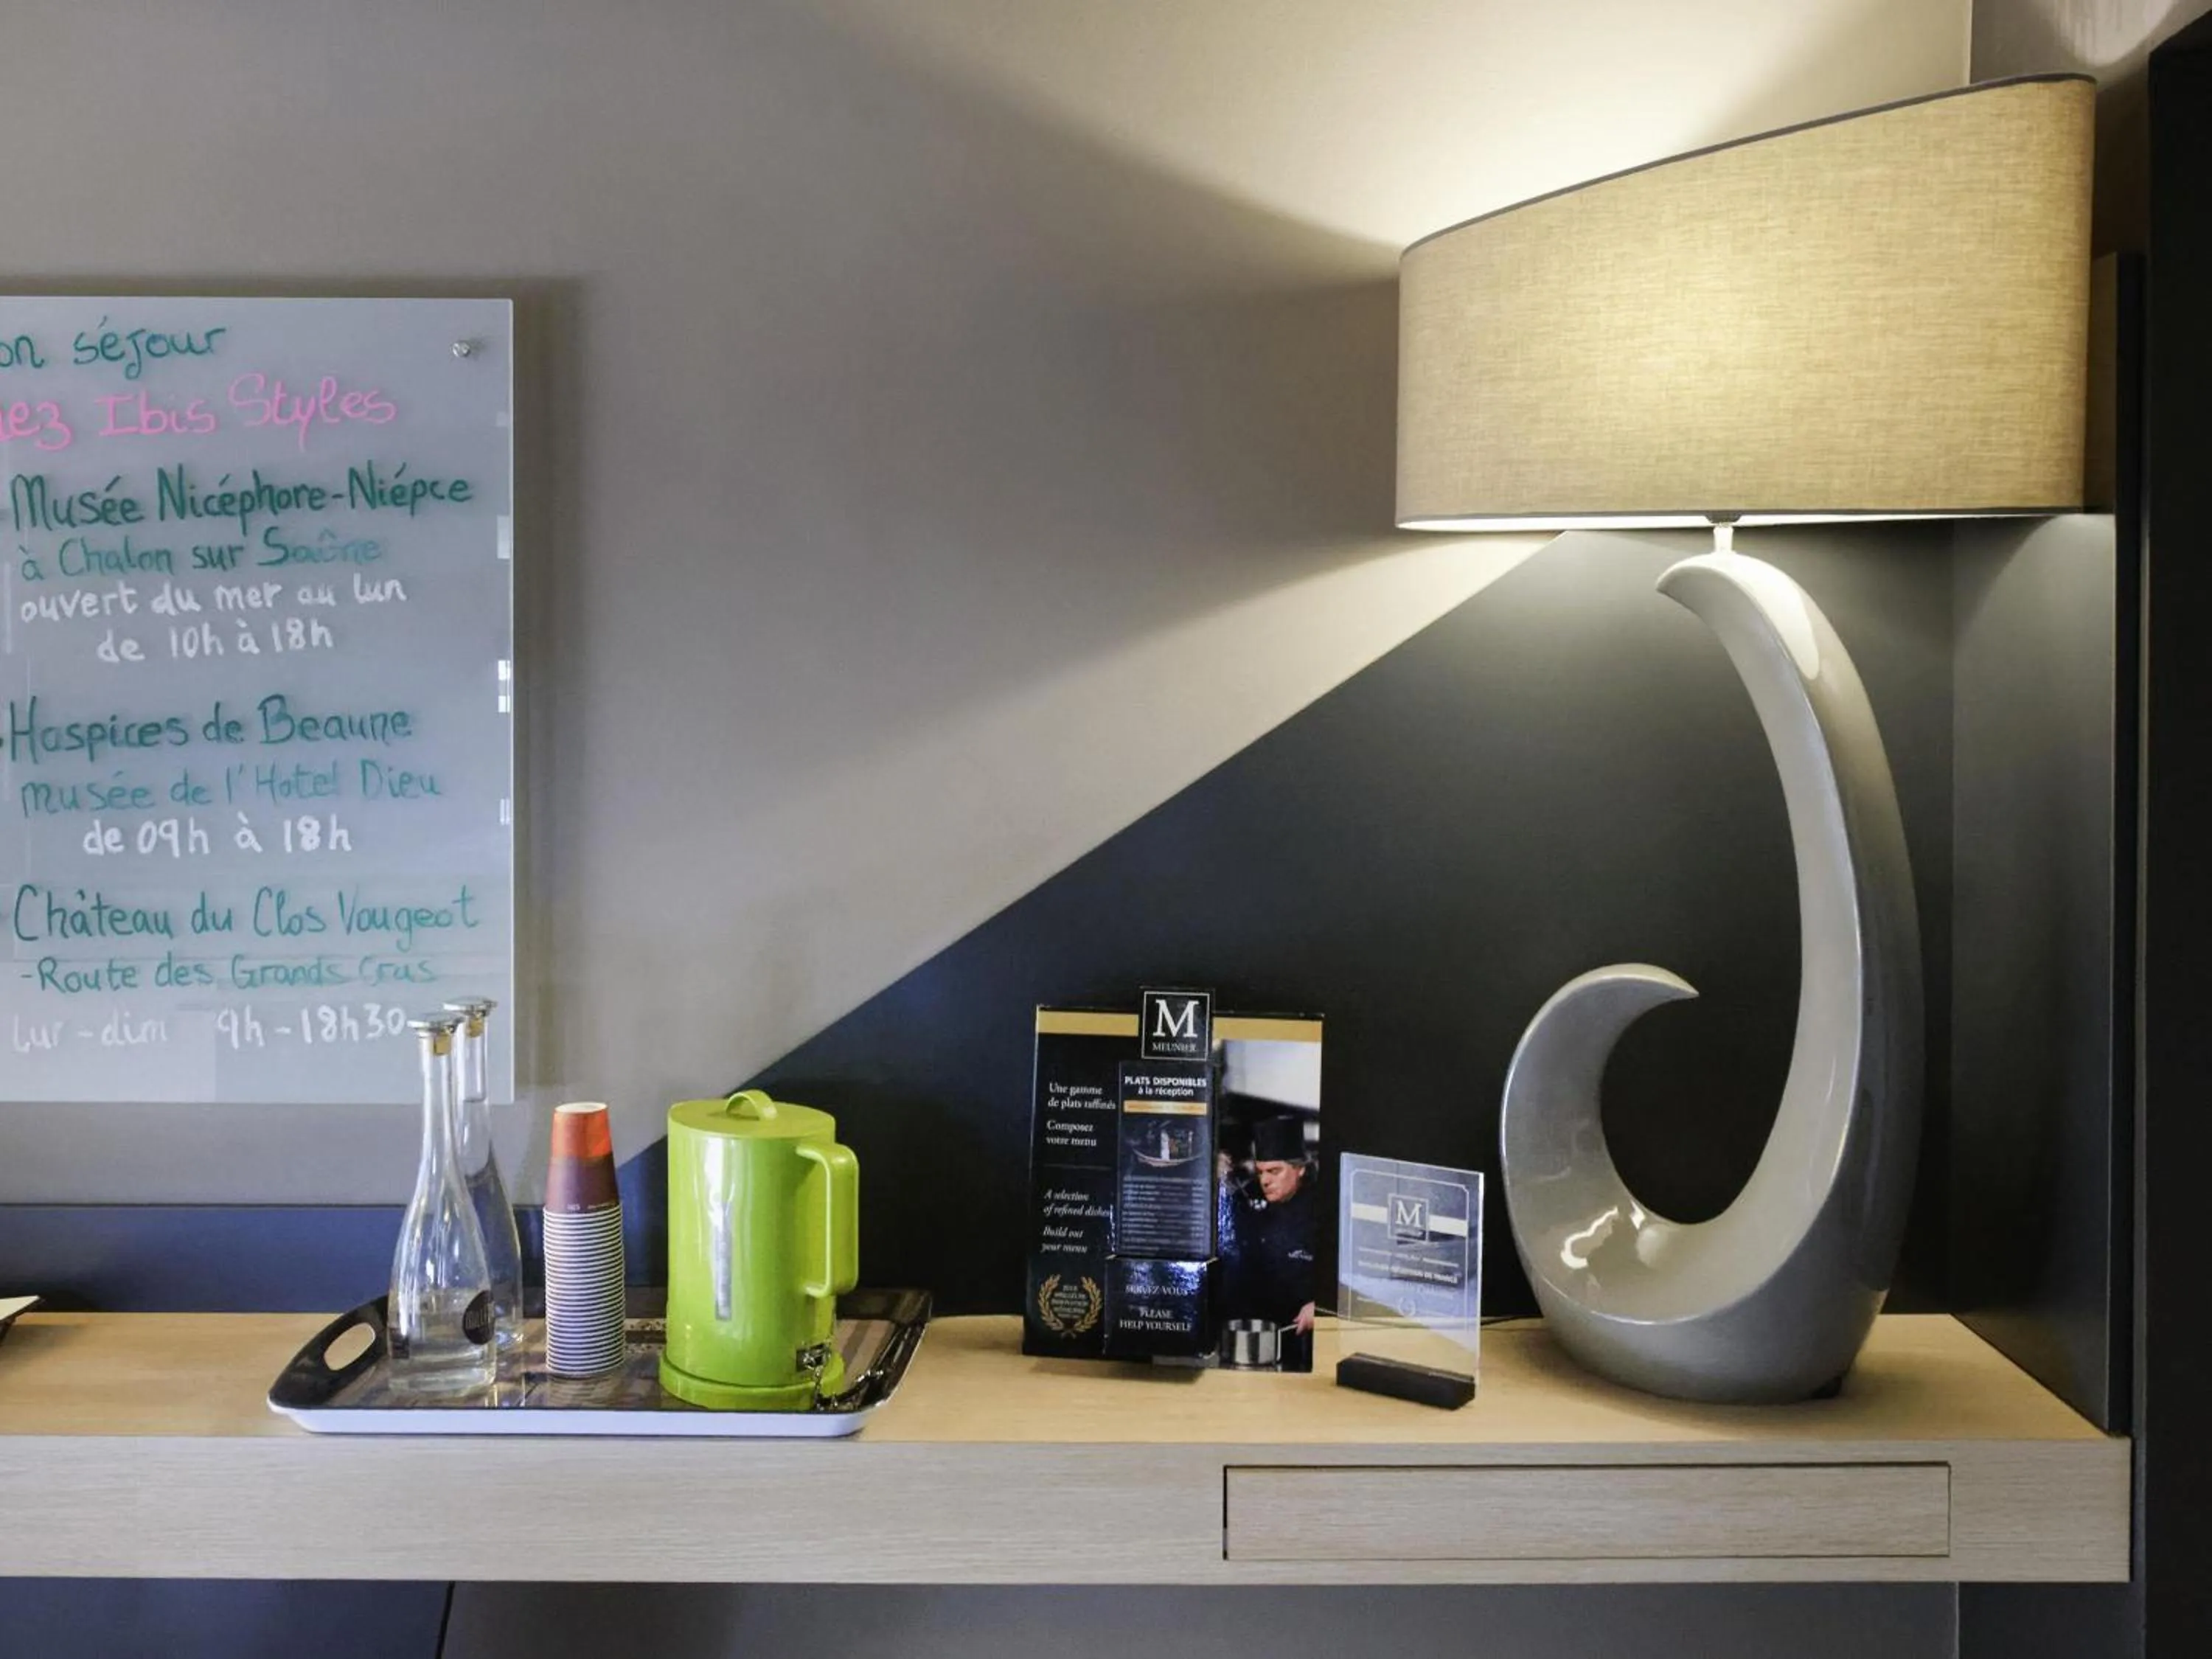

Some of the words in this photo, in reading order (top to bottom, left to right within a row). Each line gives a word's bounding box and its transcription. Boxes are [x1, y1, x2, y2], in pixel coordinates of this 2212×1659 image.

[73, 316, 226, 380] séjour
[0, 401, 72, 451] ez
[94, 388, 216, 437] Ibis
[227, 373, 398, 451] Styles
[10, 474, 145, 531] Musée
[157, 460, 473, 537] Nicéphore-Niépce
[18, 546, 44, 580] à
[59, 535, 175, 577] Chalon
[192, 545, 244, 571] sur
[20, 580, 139, 622] ouvert
[151, 580, 201, 618] du
[215, 582, 282, 612] mer
[298, 582, 336, 607] au
[353, 572, 408, 605] lun
[97, 633, 145, 662] de
[170, 624, 223, 658] 10h
[237, 620, 260, 655] à
[272, 618, 334, 653] 18h
[202, 701, 244, 743] de
[257, 693, 412, 746] Beaune
[21, 770, 155, 818] musée
[170, 768, 212, 807] de
[361, 758, 443, 799] Dieu
[83, 818, 125, 855] de
[137, 817, 210, 858] 09h
[234, 812, 262, 852] à
[283, 813, 352, 854] 18h
[15, 883, 174, 942] Château
[192, 891, 232, 934] du
[254, 886, 327, 936] Clos
[155, 950, 214, 987] des
[231, 953, 348, 990] Grands
[1152, 998, 1200, 1038] M
[1048, 1082, 1068, 1093] Une
[1048, 1096, 1060, 1107] de
[1061, 1096, 1082, 1110] plats
[1124, 1075, 1150, 1086] PLATS
[1152, 1076, 1207, 1088] DISPONIBLES
[1145, 1086, 1152, 1095] la
[1155, 1087, 1194, 1098] réception
[1071, 1136, 1097, 1147] menu
[1395, 1200, 1422, 1228] M
[1119, 1319, 1144, 1331] HELP
[1145, 1321, 1192, 1332] YOURSELF
